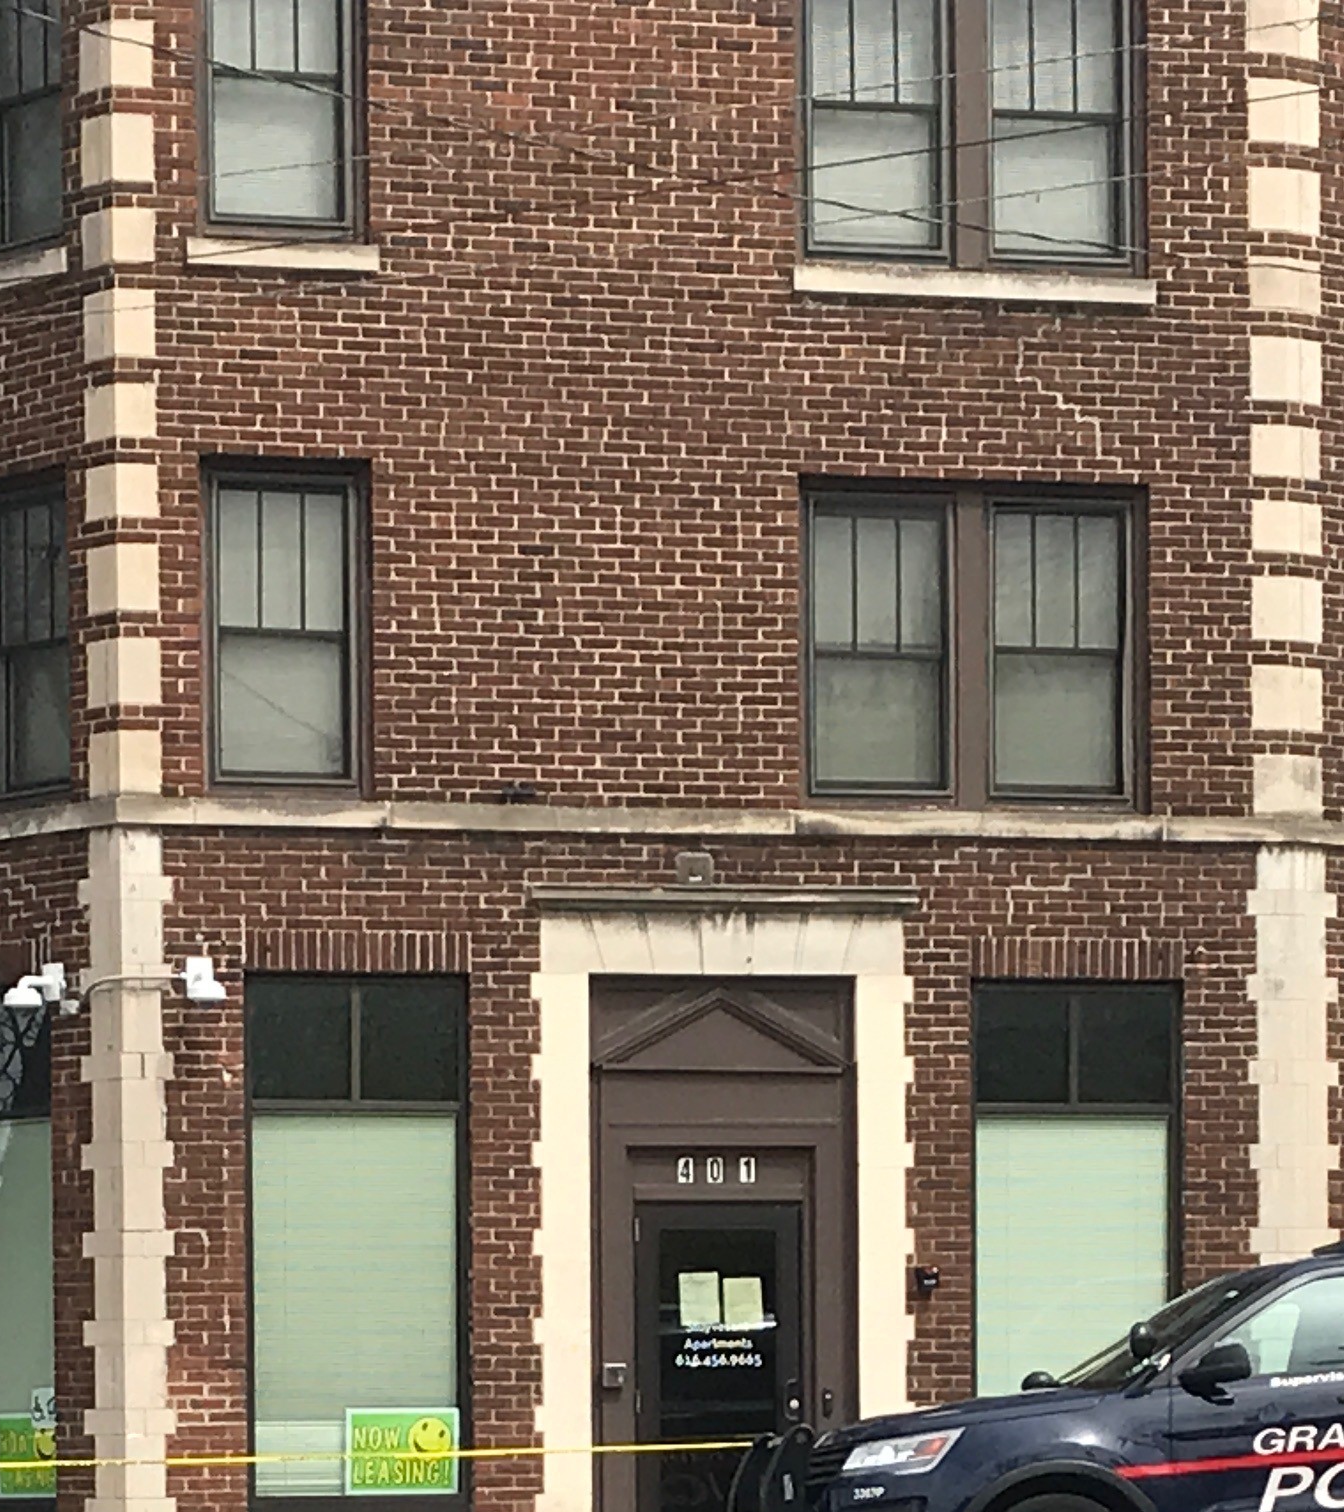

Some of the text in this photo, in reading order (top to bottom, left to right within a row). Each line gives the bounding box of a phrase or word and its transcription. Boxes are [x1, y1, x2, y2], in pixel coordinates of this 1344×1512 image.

[678, 1158, 755, 1183] 401
[684, 1338, 753, 1351] Apartments
[354, 1426, 400, 1449] NOW
[353, 1460, 450, 1484] LEASING!
